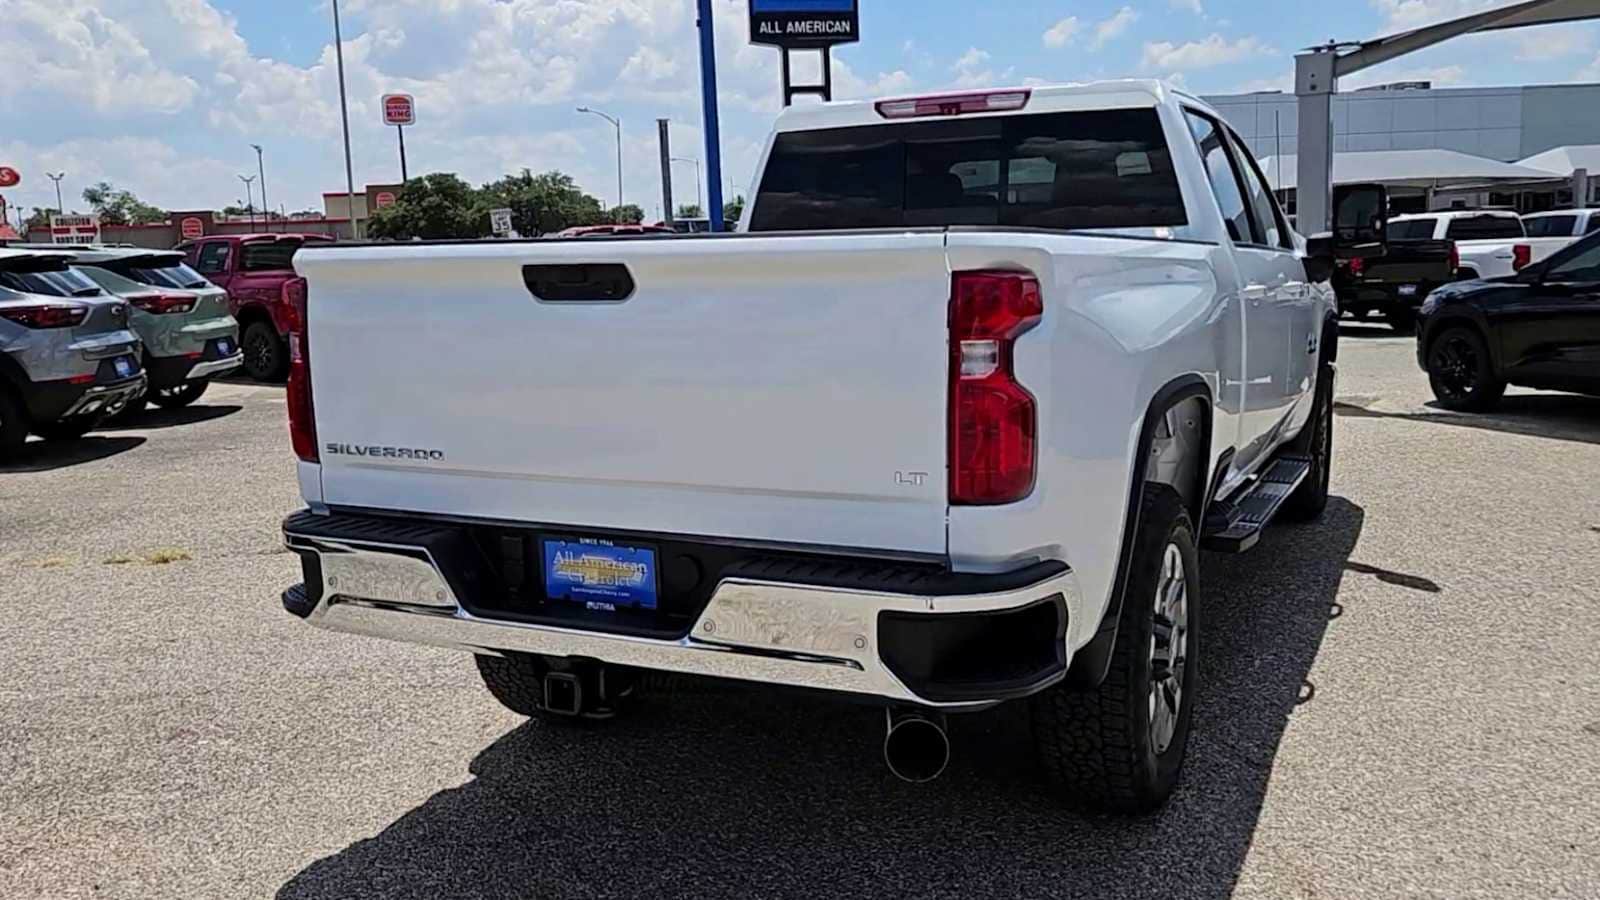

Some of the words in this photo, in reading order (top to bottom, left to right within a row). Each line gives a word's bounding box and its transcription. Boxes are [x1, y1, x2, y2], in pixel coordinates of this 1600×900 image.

[760, 20, 783, 34] ALL
[786, 20, 851, 34] AMERICAN
[387, 110, 411, 118] KING
[495, 220, 510, 231] 35
[326, 442, 445, 461] SILVERADO
[894, 470, 929, 487] LT
[579, 537, 598, 546] SINCE
[553, 550, 574, 566] All
[580, 553, 647, 574] American
